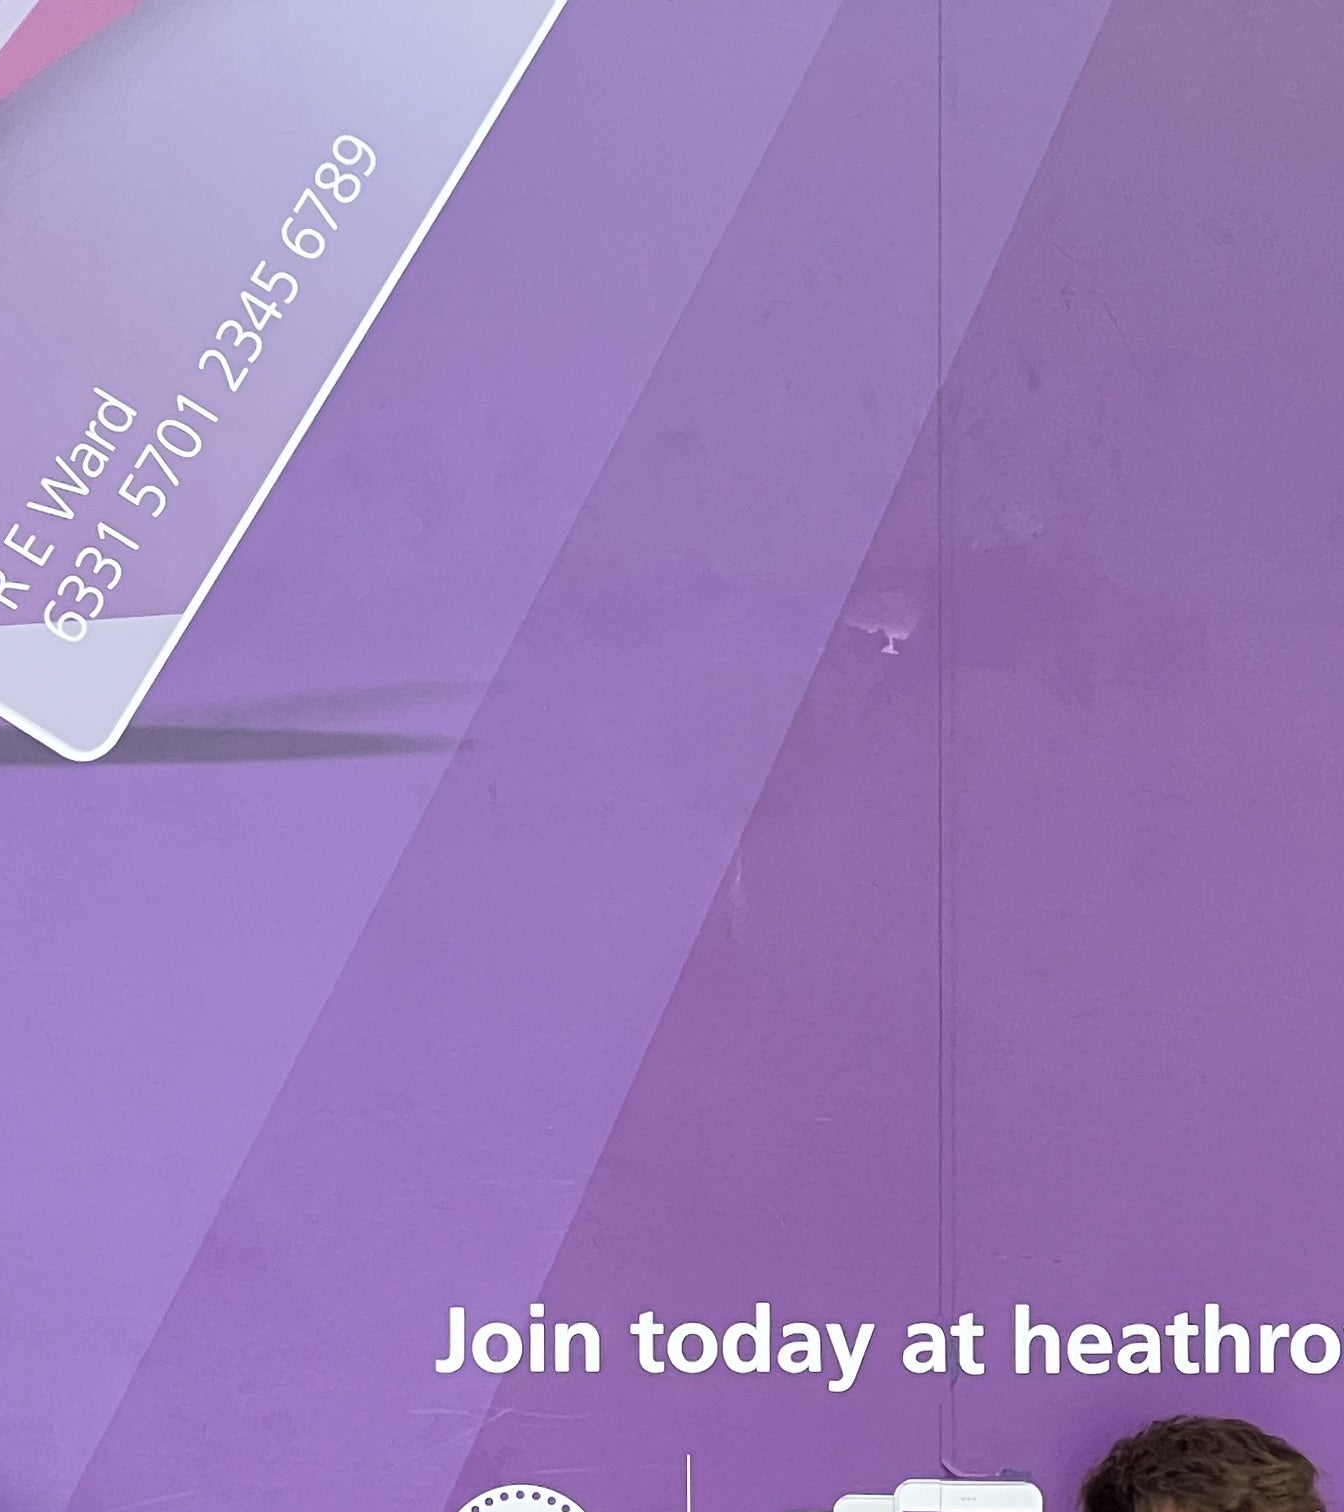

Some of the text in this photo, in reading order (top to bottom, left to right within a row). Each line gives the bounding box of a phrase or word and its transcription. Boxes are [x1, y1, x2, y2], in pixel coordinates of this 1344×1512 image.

[43, 134, 376, 642] 6331 5701 2345 6789
[26, 387, 138, 520] Ward
[3, 524, 54, 566] E
[435, 1303, 600, 1374] Join
[630, 1302, 875, 1392] today
[902, 1312, 985, 1375] at
